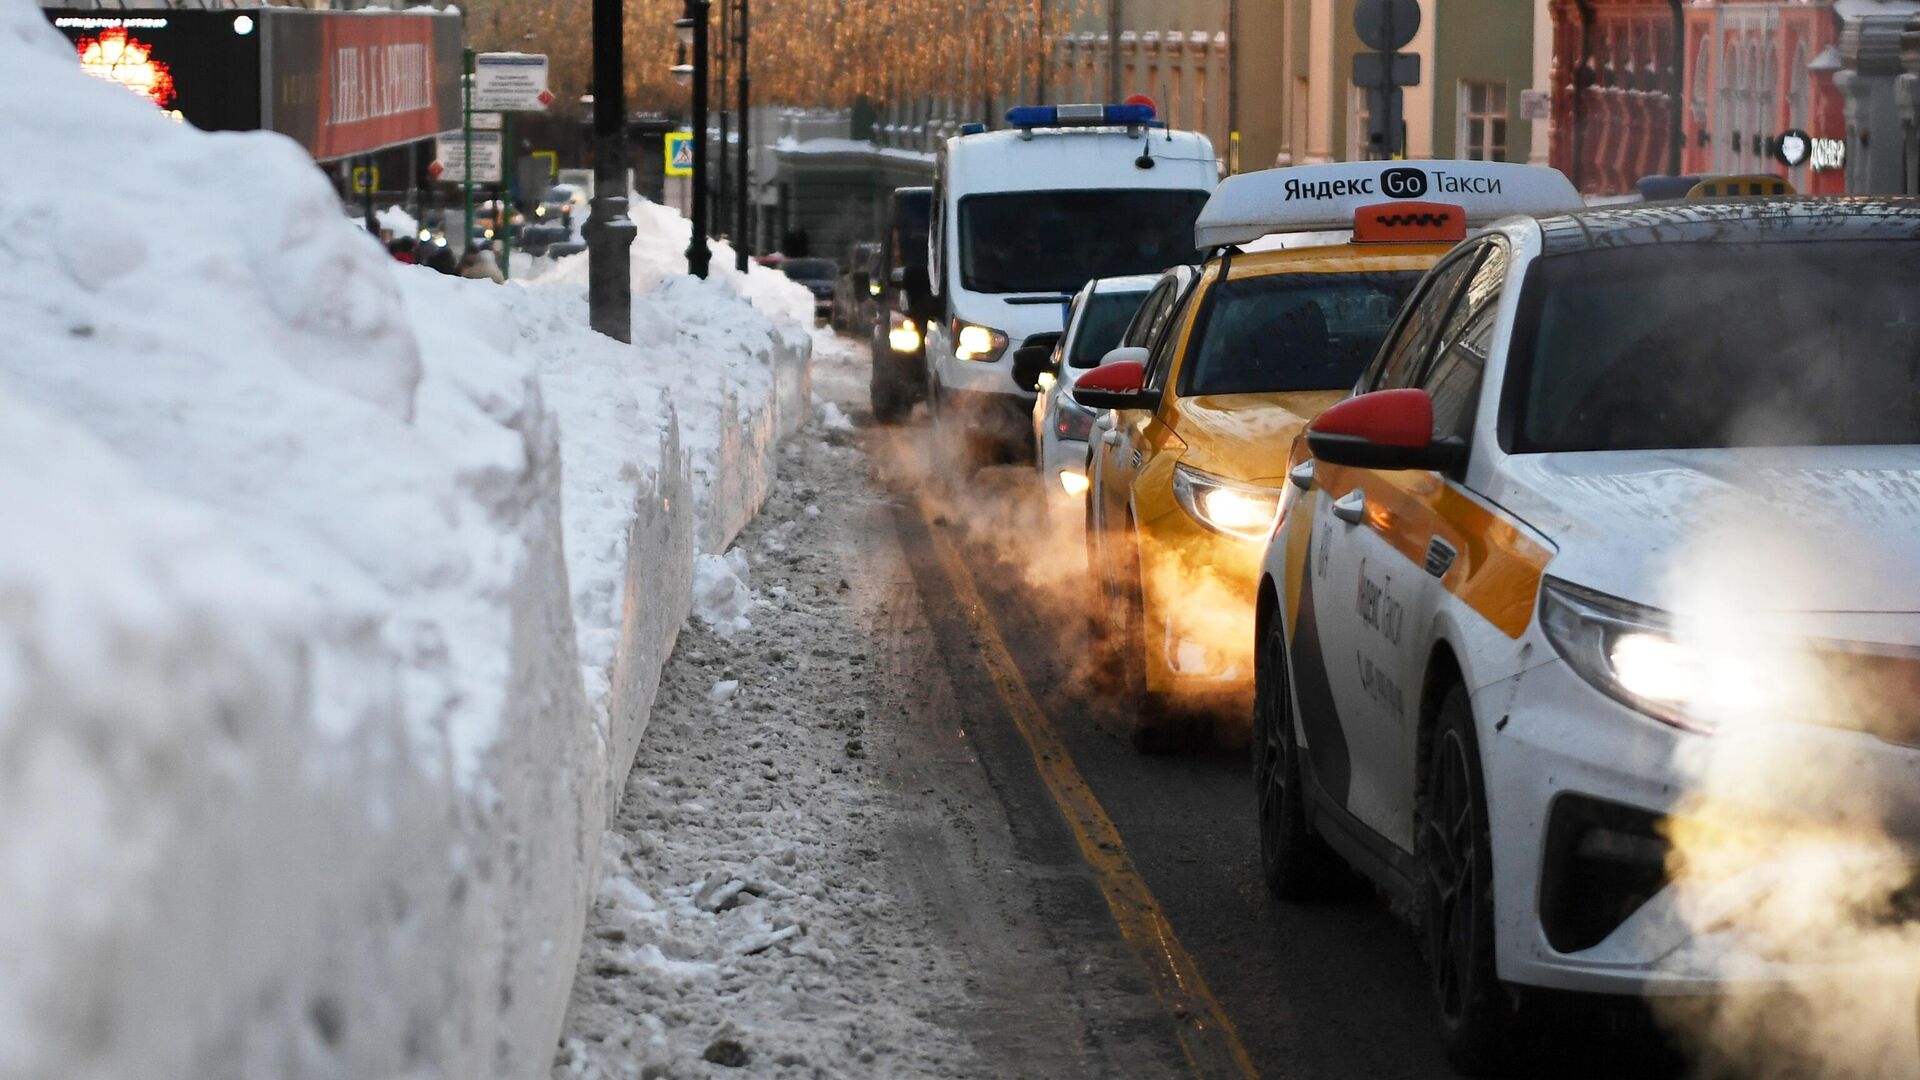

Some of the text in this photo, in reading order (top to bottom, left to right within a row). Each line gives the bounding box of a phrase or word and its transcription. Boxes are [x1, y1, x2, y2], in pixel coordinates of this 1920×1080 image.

[1810, 137, 1845, 171] ДОНЕР
[1284, 171, 1501, 201] Яндекс Go Такси
